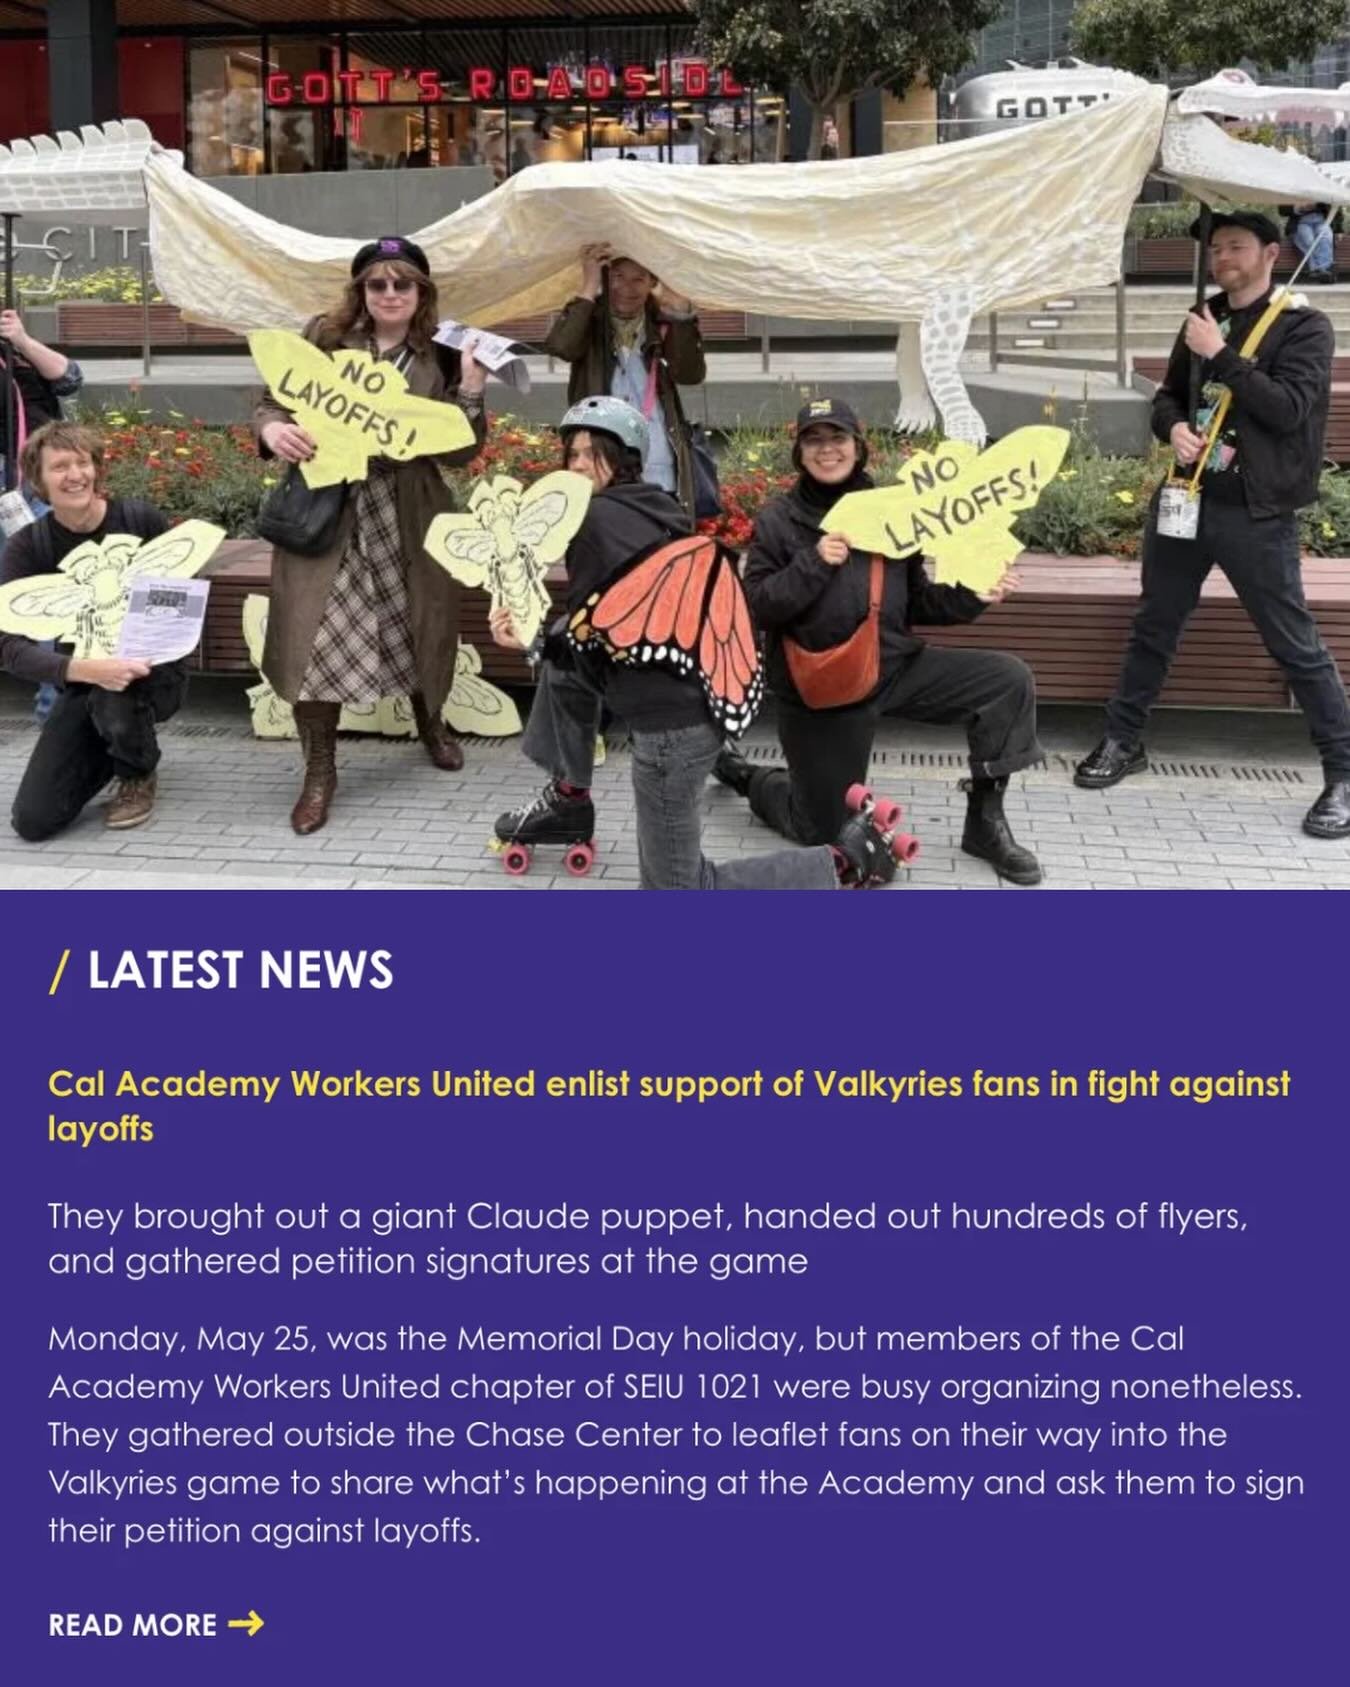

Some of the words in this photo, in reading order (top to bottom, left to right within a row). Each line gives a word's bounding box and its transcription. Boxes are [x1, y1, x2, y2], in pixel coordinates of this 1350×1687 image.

[266, 69, 443, 102] GOTT'S
[996, 93, 1110, 119] GOTT'
[43, 226, 138, 261] CIT
[340, 359, 386, 394] NO
[911, 457, 959, 495] NO
[885, 459, 1039, 551] LAYOFFS!
